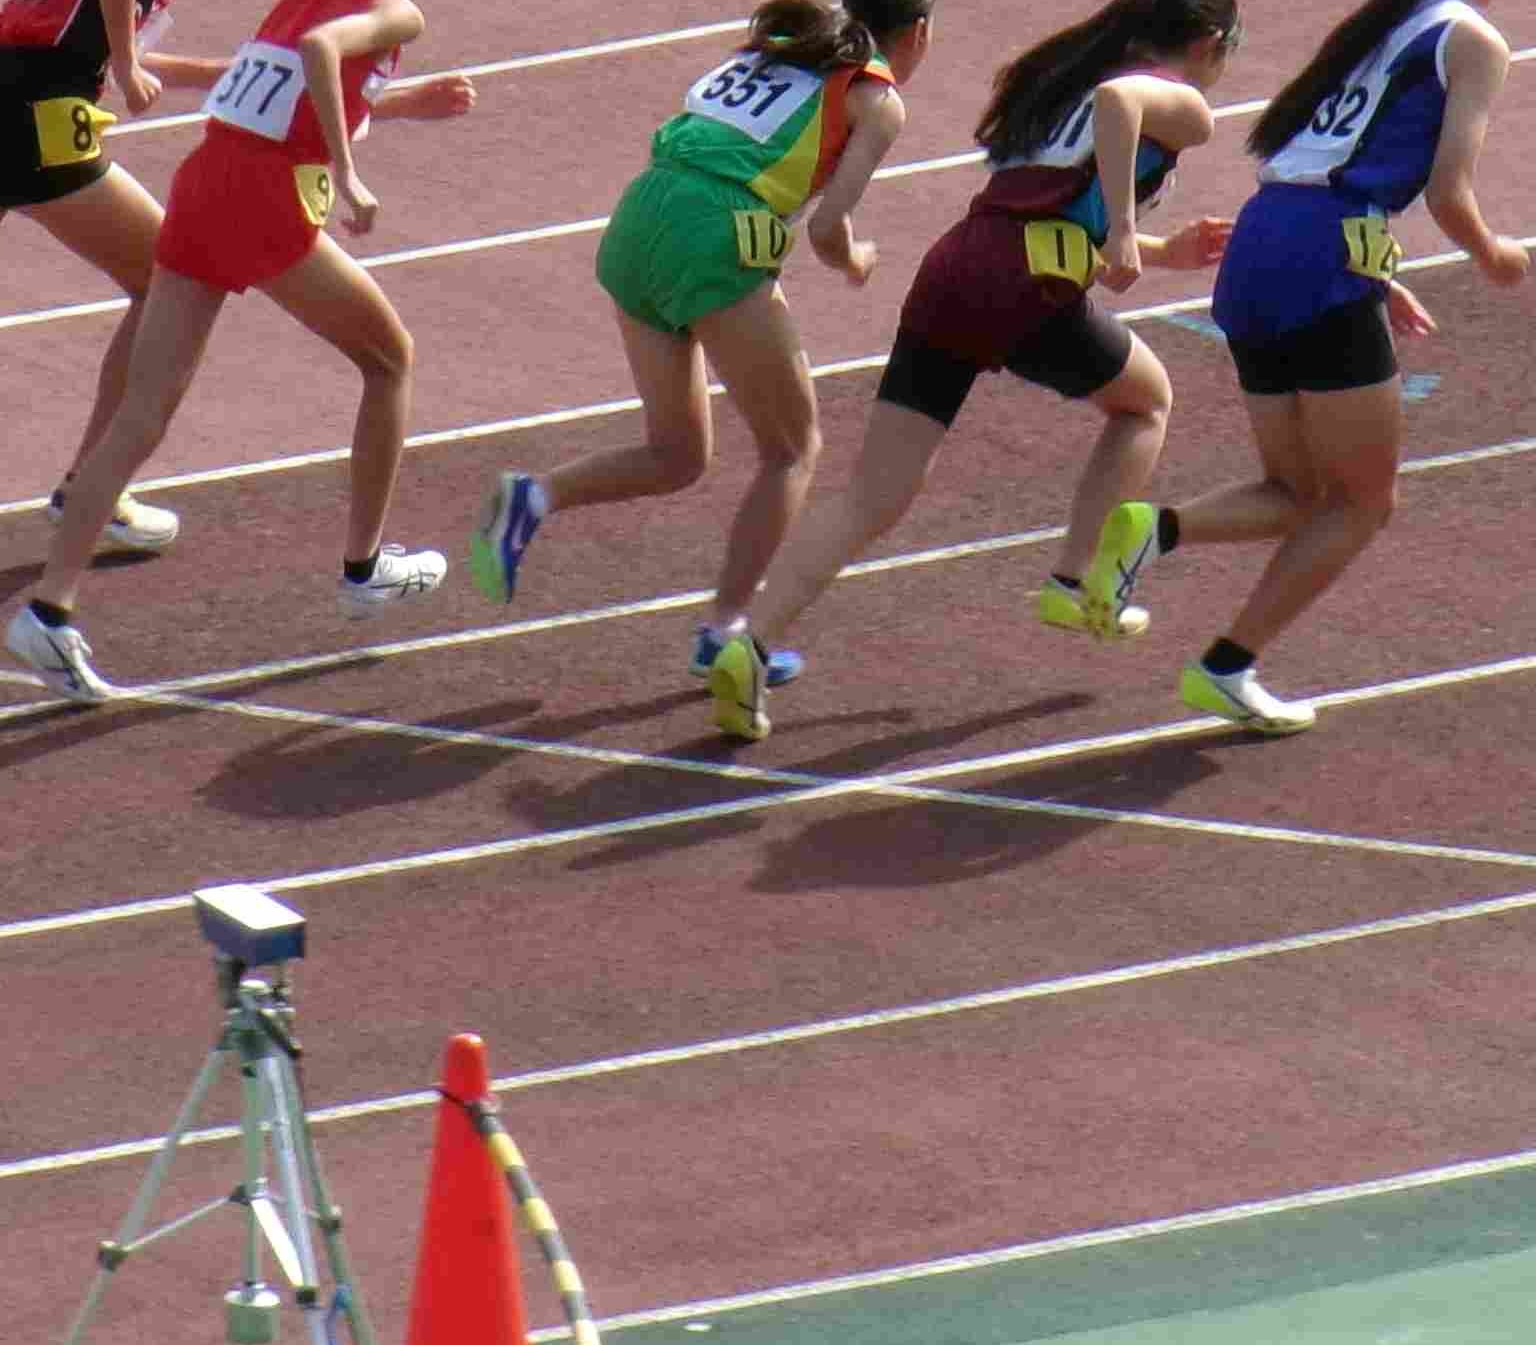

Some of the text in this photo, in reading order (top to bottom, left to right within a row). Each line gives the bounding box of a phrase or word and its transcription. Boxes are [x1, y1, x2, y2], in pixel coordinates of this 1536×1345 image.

[701, 62, 793, 118] 551
[71, 104, 93, 152] 8
[747, 214, 788, 260] 10
